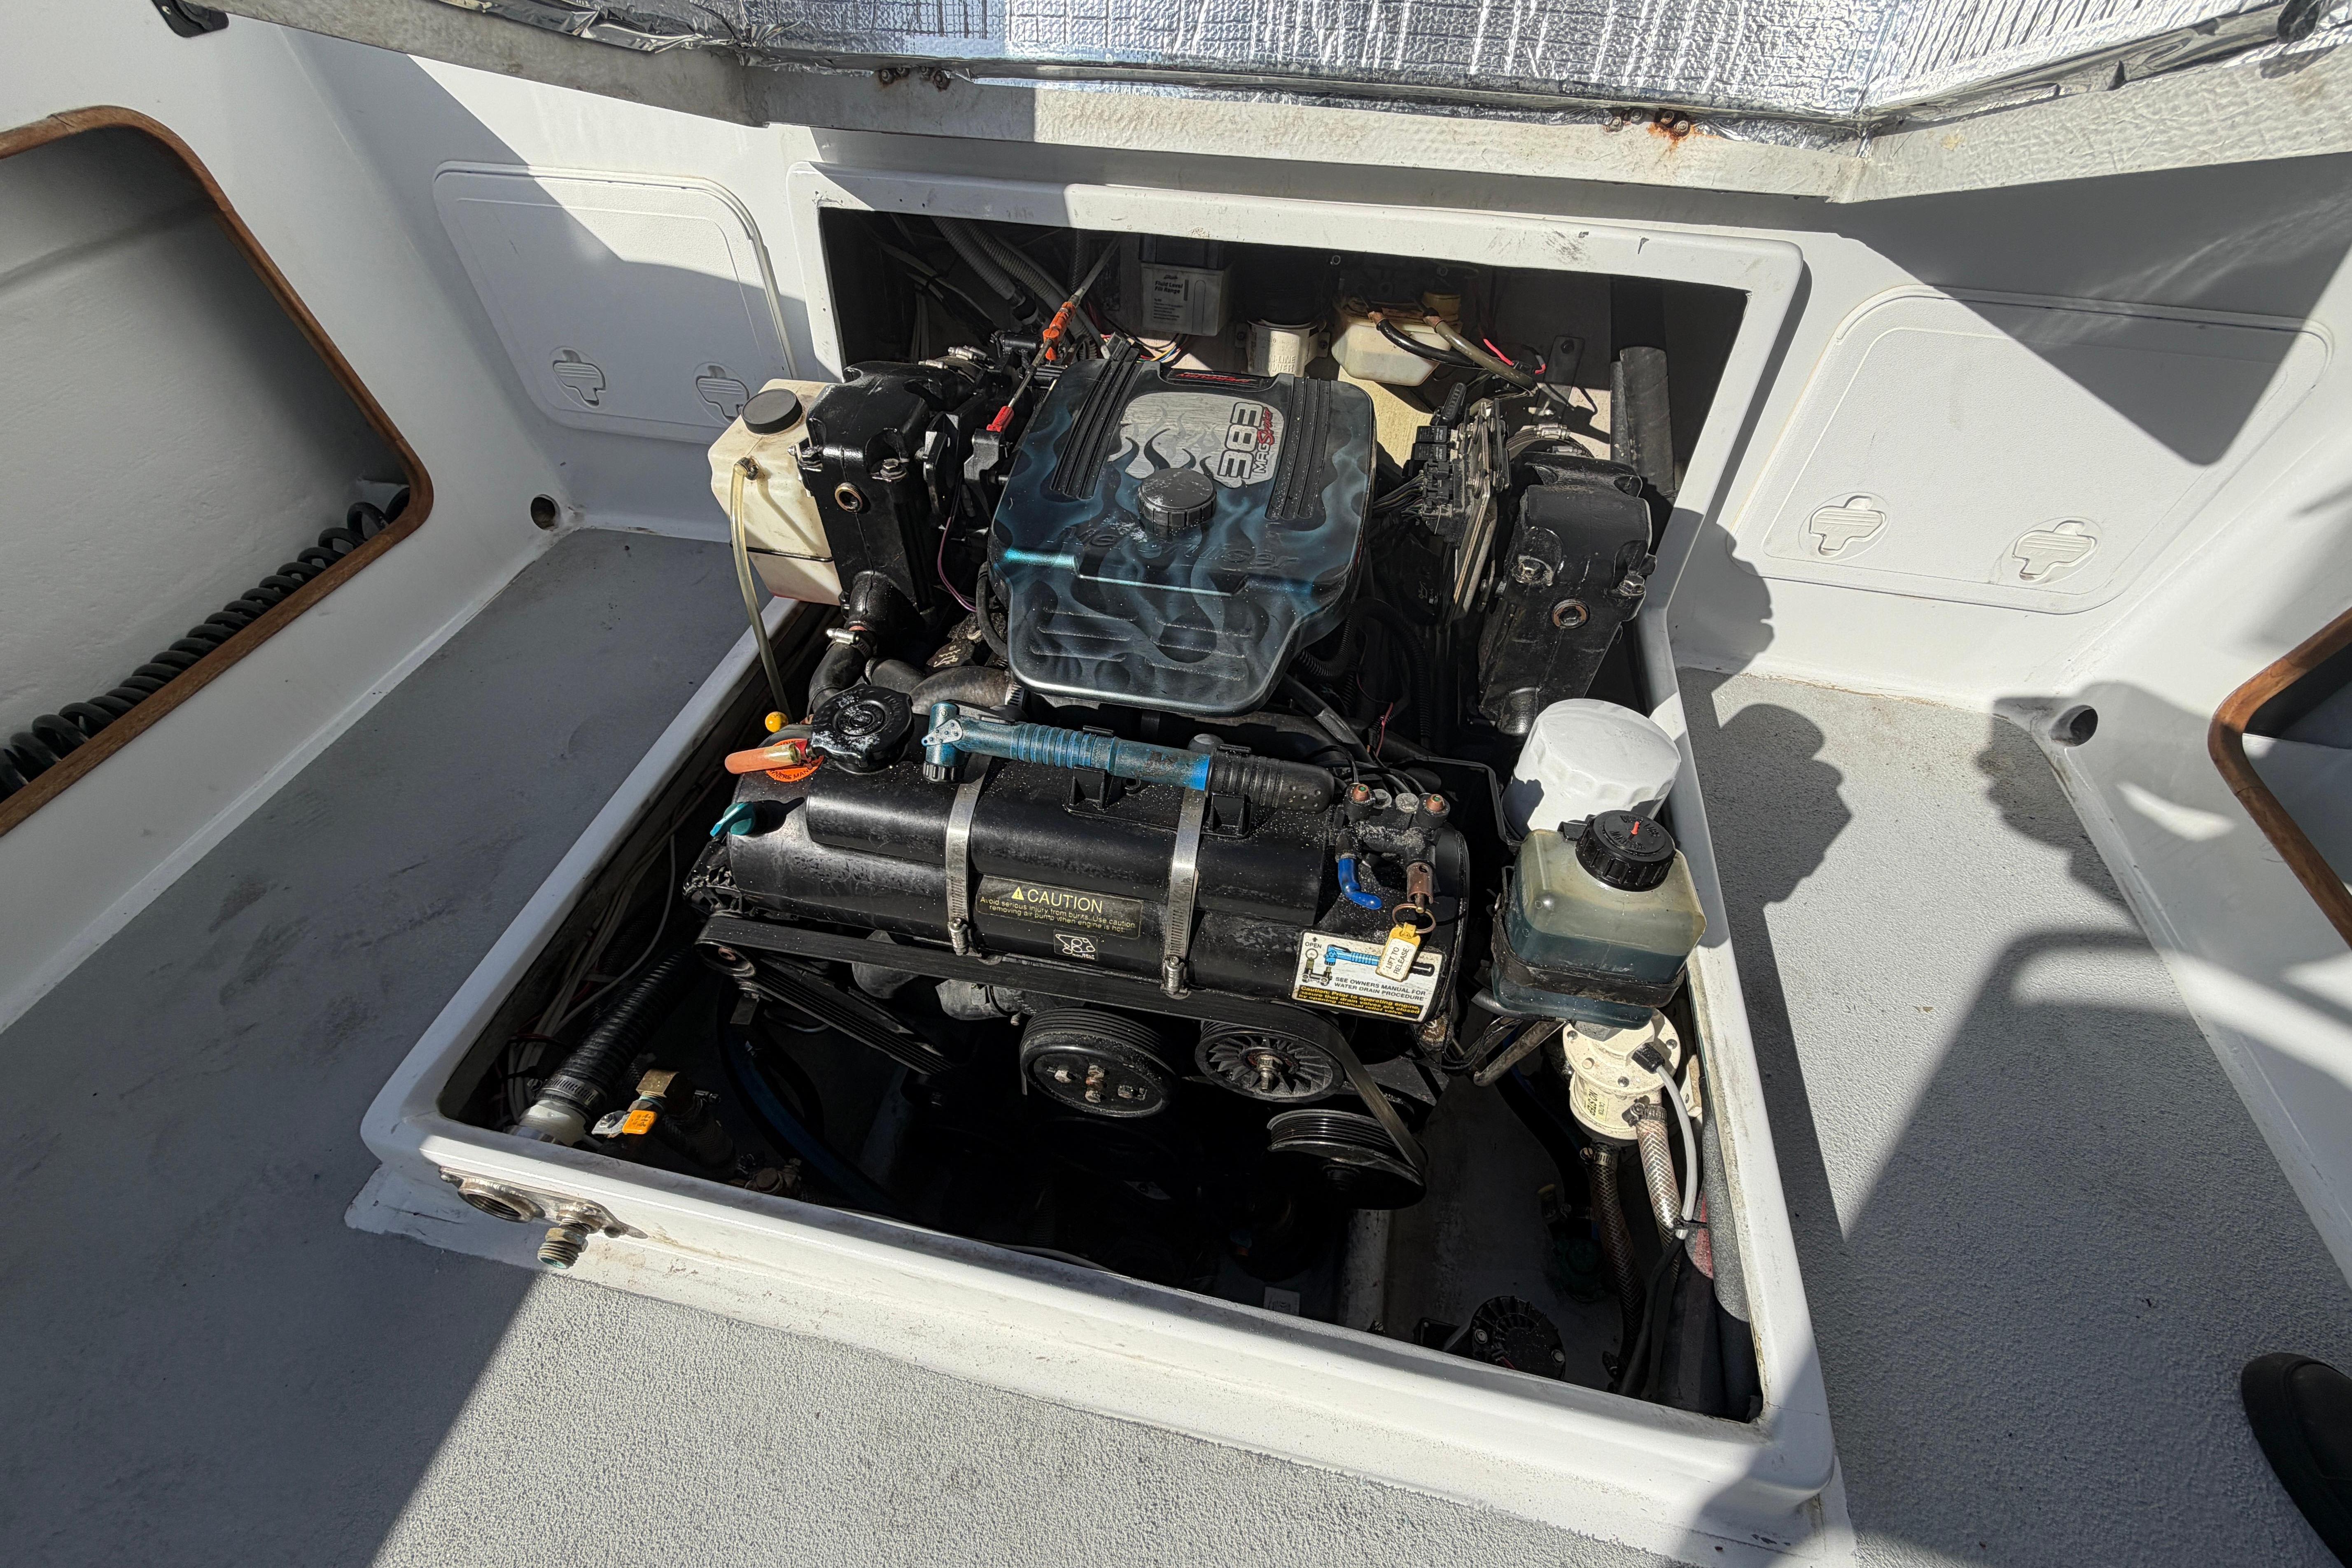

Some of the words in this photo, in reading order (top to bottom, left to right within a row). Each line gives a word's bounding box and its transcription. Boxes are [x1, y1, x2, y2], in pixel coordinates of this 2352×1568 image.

[1266, 355, 1296, 364] N-LINE
[1217, 401, 1264, 479] 383
[980, 896, 1000, 905] Avoid
[1001, 901, 1027, 910] serious
[1029, 905, 1049, 914] injury
[1050, 908, 1066, 916] from
[1092, 915, 1107, 923] Use
[1109, 919, 1135, 928] caution
[1027, 889, 1103, 914] CAUTION
[989, 905, 1022, 916] removing
[1034, 913, 1055, 921] pump
[1077, 920, 1102, 929] engine
[1386, 956, 1395, 969] LIFT
[1391, 947, 1399, 955] TO
[1393, 947, 1409, 975] RELEASE
[1301, 986, 1330, 994] Caution:
[1359, 997, 1393, 1006] operating
[1350, 979, 1380, 988] OWNERS
[1381, 984, 1410, 993] MANUAL
[1381, 990, 1424, 1001] PROCEDURE
[1589, 1089, 1598, 1101] NO
[1587, 1098, 1597, 1116] STEP
